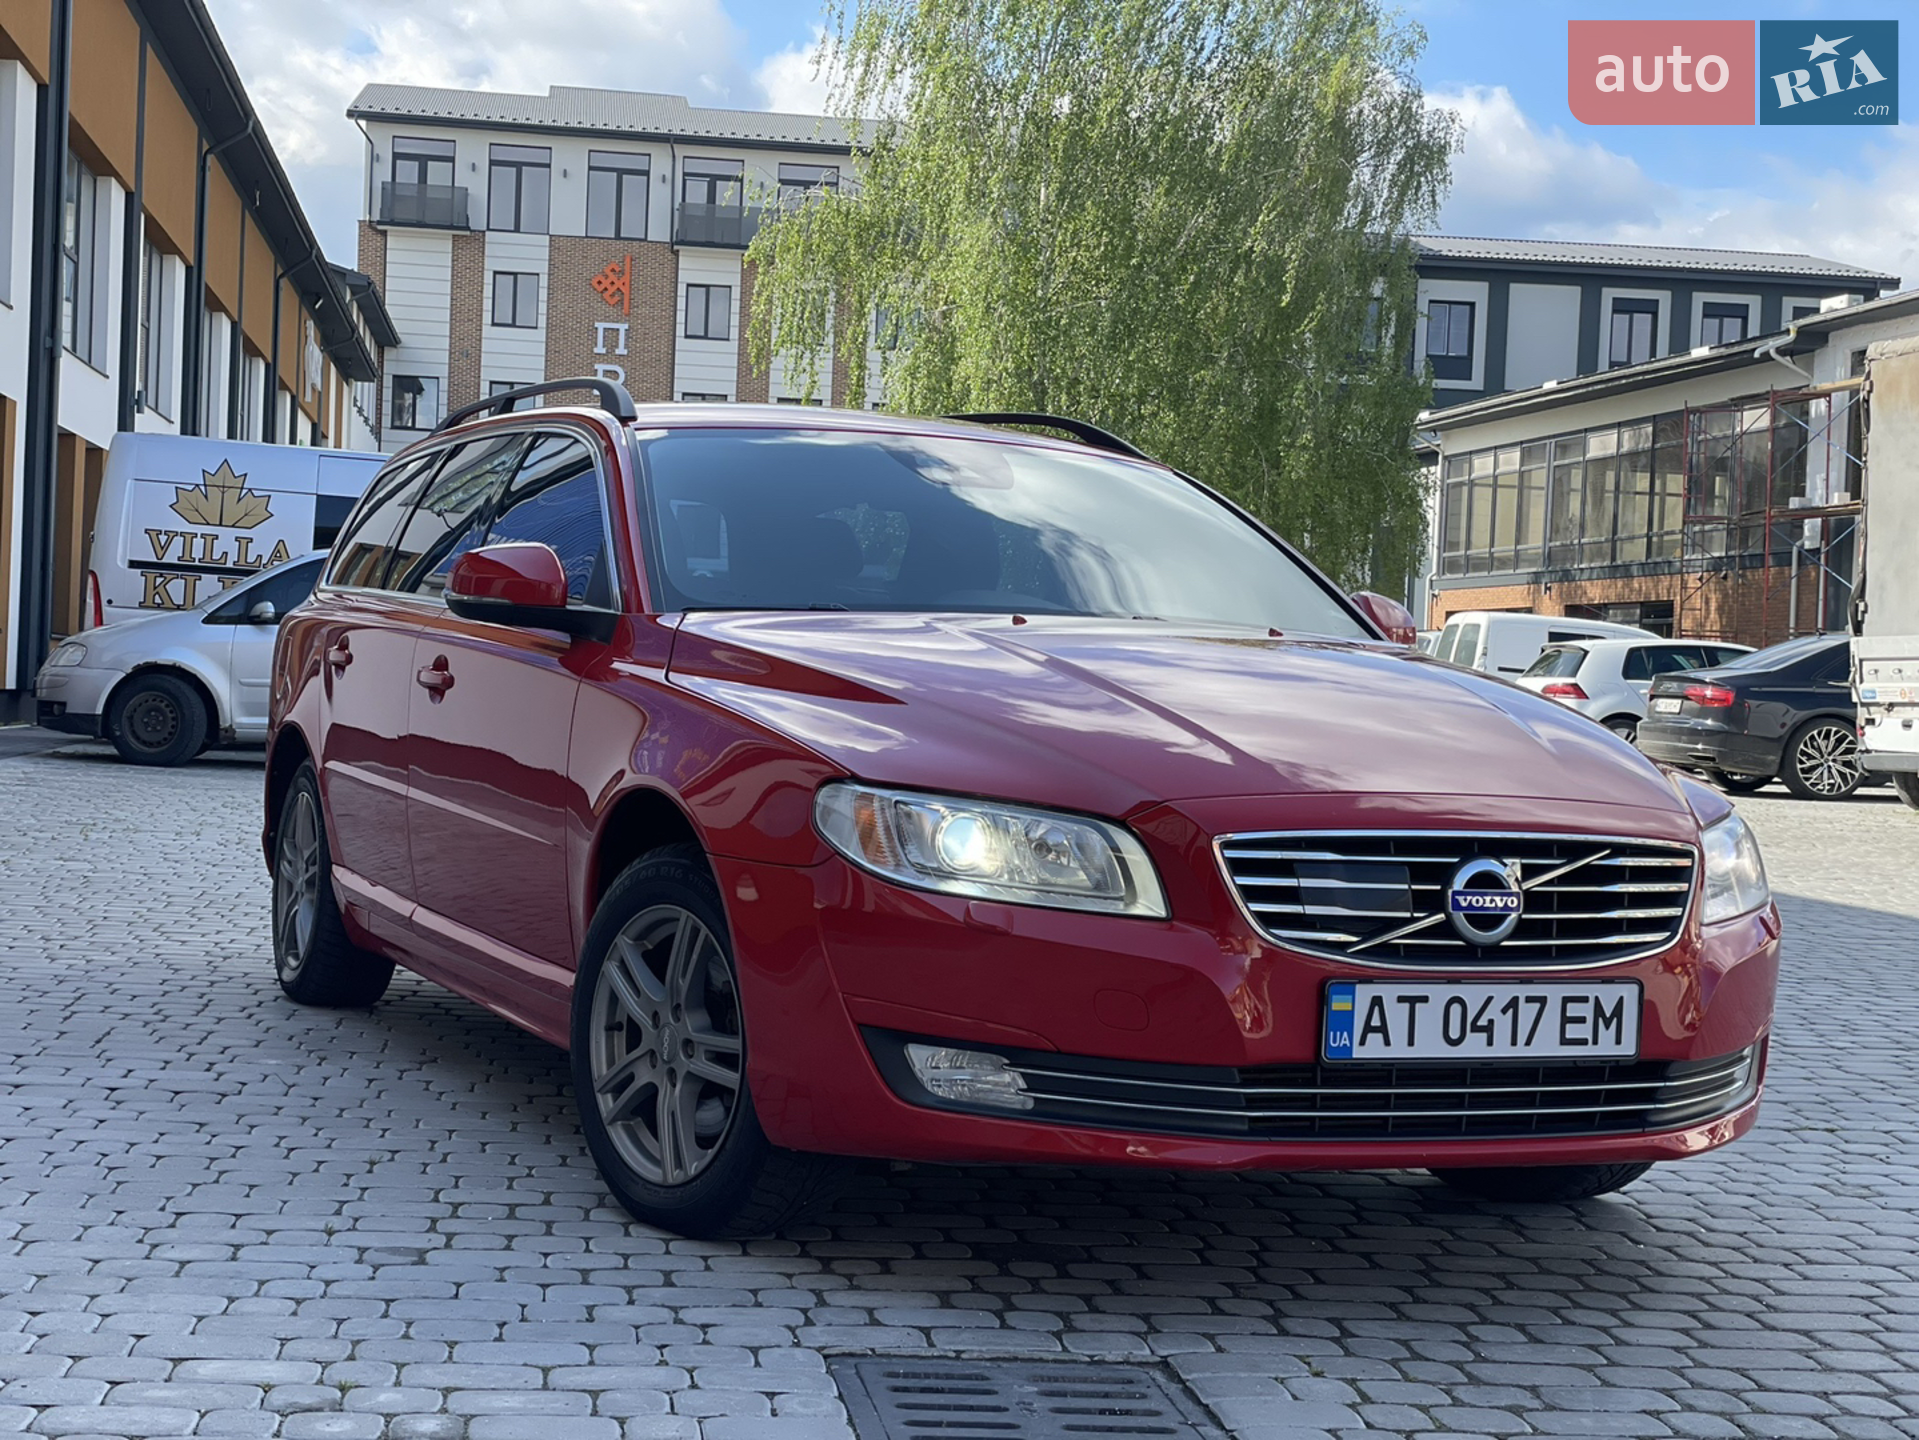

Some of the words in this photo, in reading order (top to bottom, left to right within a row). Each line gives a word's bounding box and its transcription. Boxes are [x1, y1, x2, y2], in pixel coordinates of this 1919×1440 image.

[144, 528, 290, 569] VILLA
[1455, 895, 1518, 908] VOLVO
[1358, 994, 1430, 1048] AT
[1442, 994, 1548, 1048] 0417
[1559, 994, 1624, 1047] EM
[1329, 1031, 1351, 1048] UA
